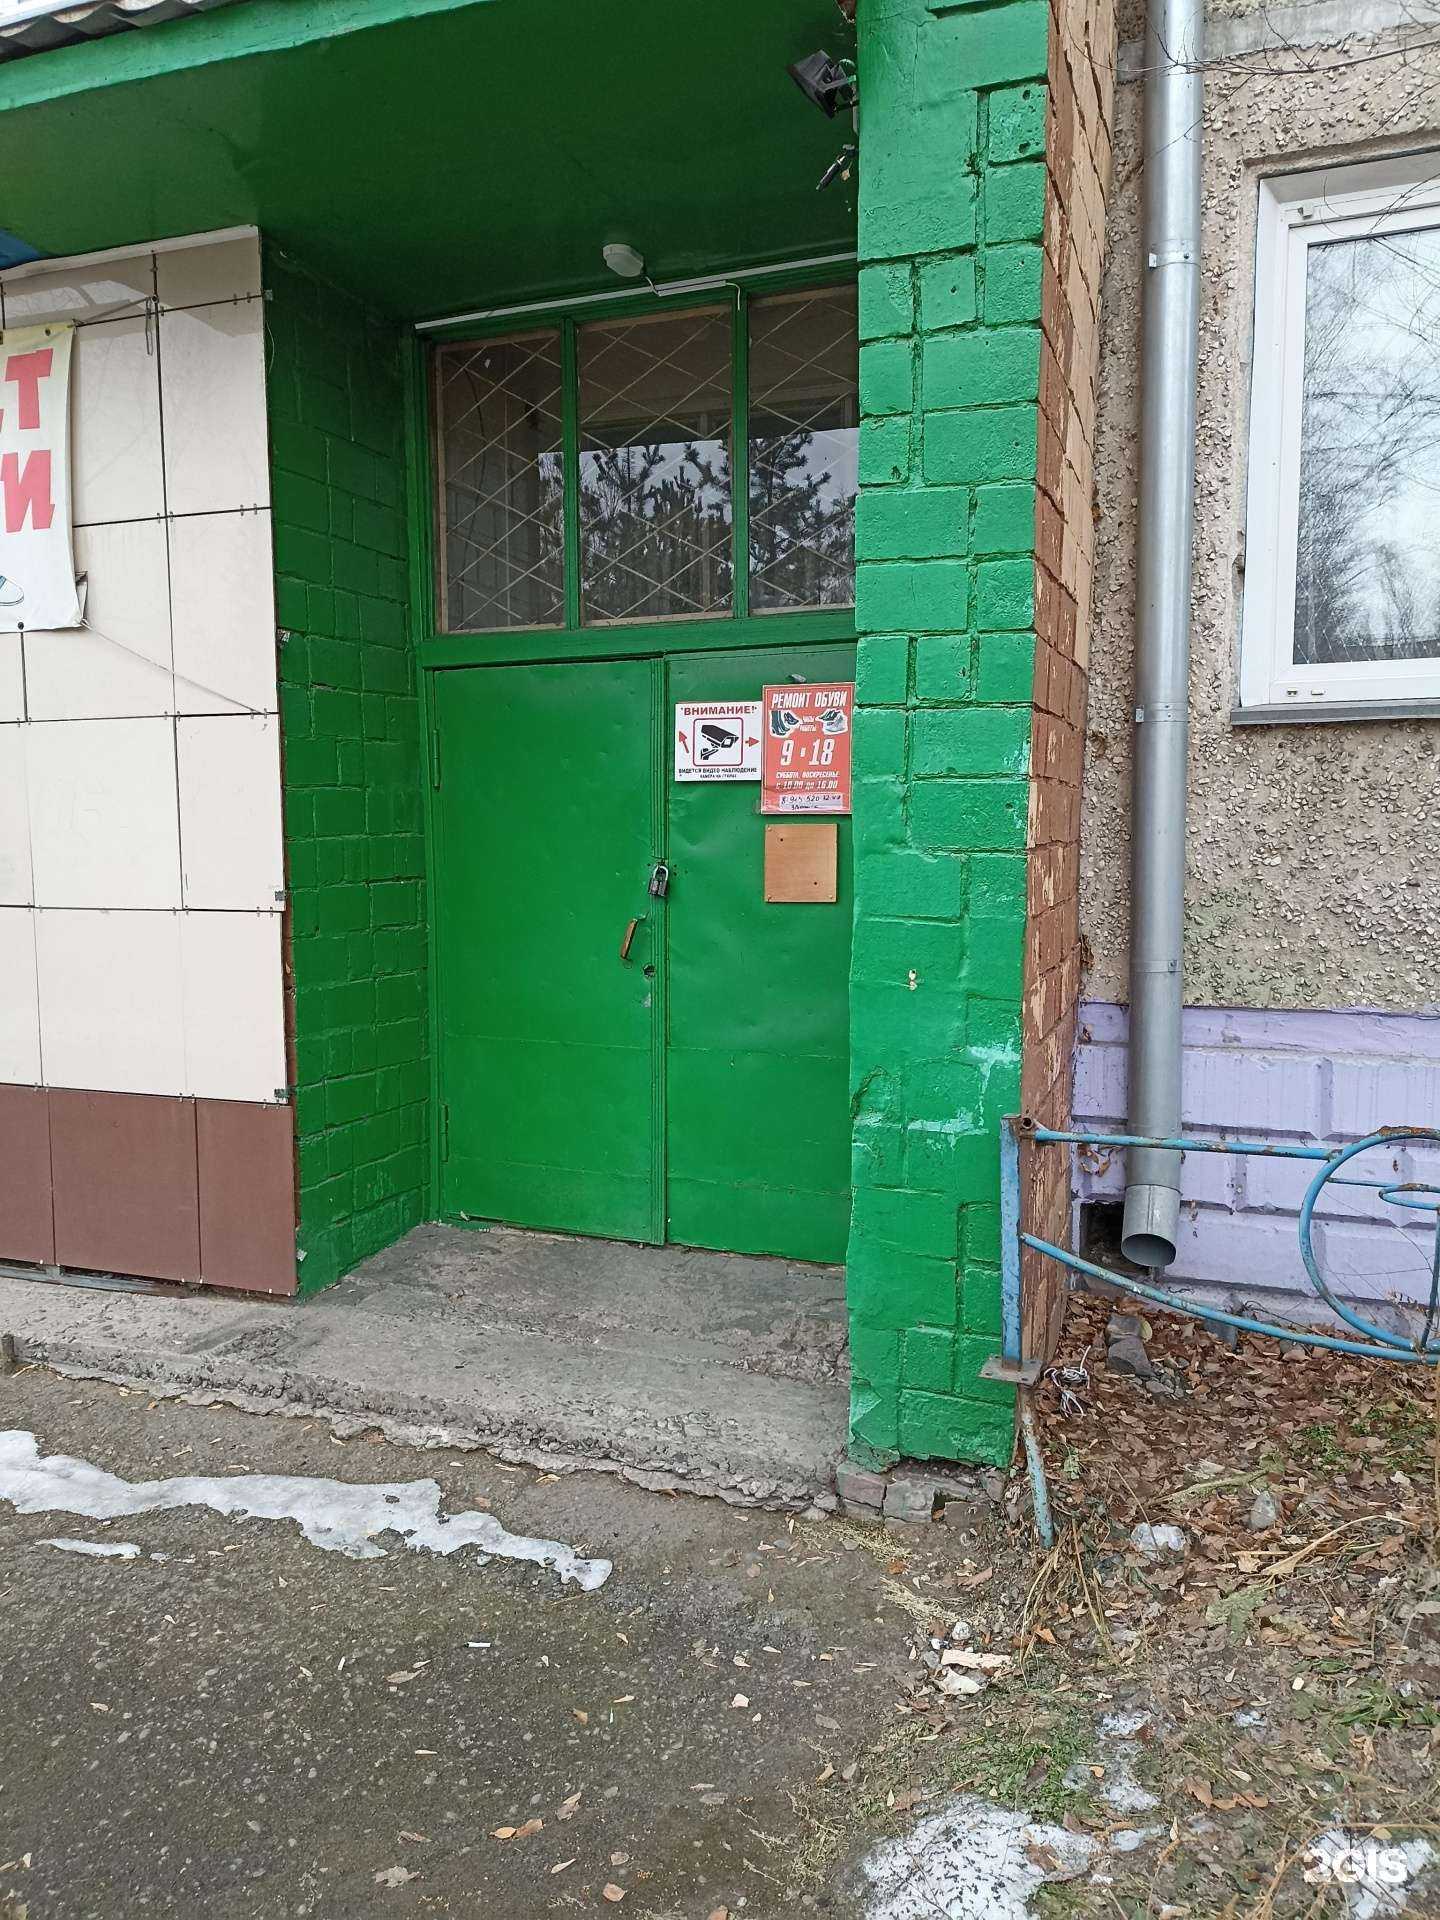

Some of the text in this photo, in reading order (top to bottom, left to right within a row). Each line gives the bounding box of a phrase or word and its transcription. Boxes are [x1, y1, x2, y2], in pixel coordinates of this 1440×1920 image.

[771, 690, 848, 708] РЕМОНТ ОБУВИ
[683, 705, 756, 716] ВНИМАНИЕ!
[780, 739, 795, 766] 9
[808, 738, 836, 766] 18
